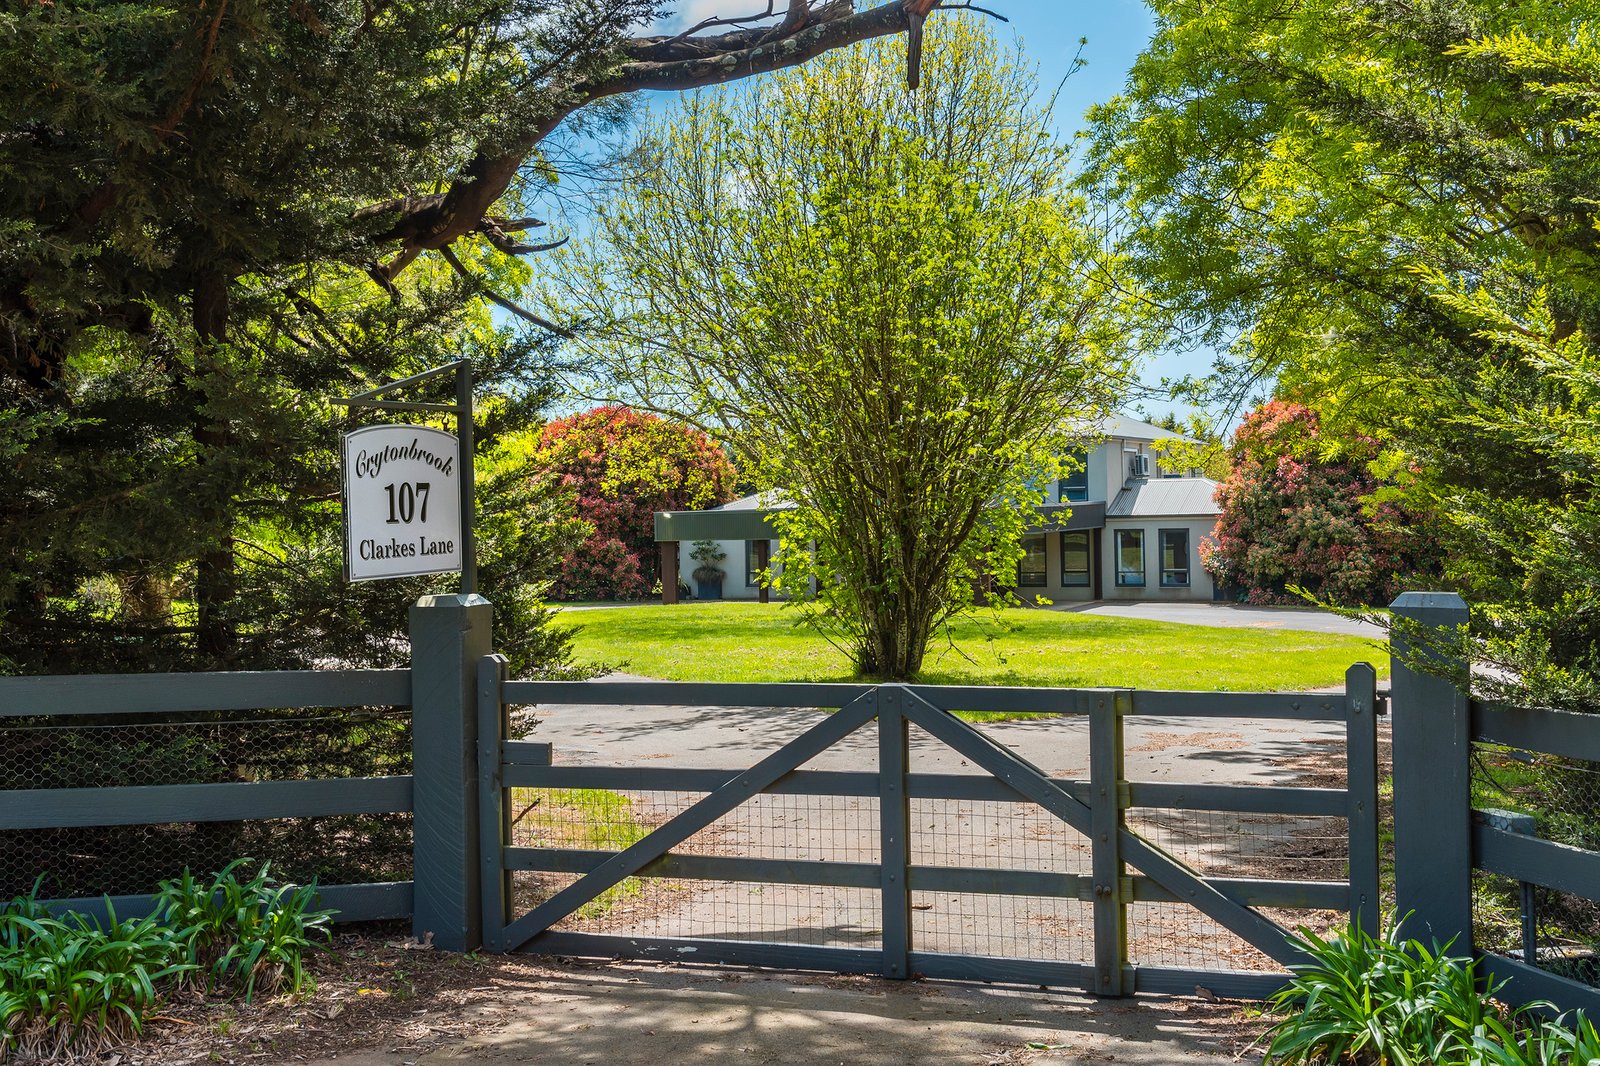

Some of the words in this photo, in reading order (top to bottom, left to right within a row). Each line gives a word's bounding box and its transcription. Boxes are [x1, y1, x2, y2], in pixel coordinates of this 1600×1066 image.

[384, 482, 431, 524] 107
[360, 538, 416, 560] Clarkes
[420, 536, 454, 556] Lane
